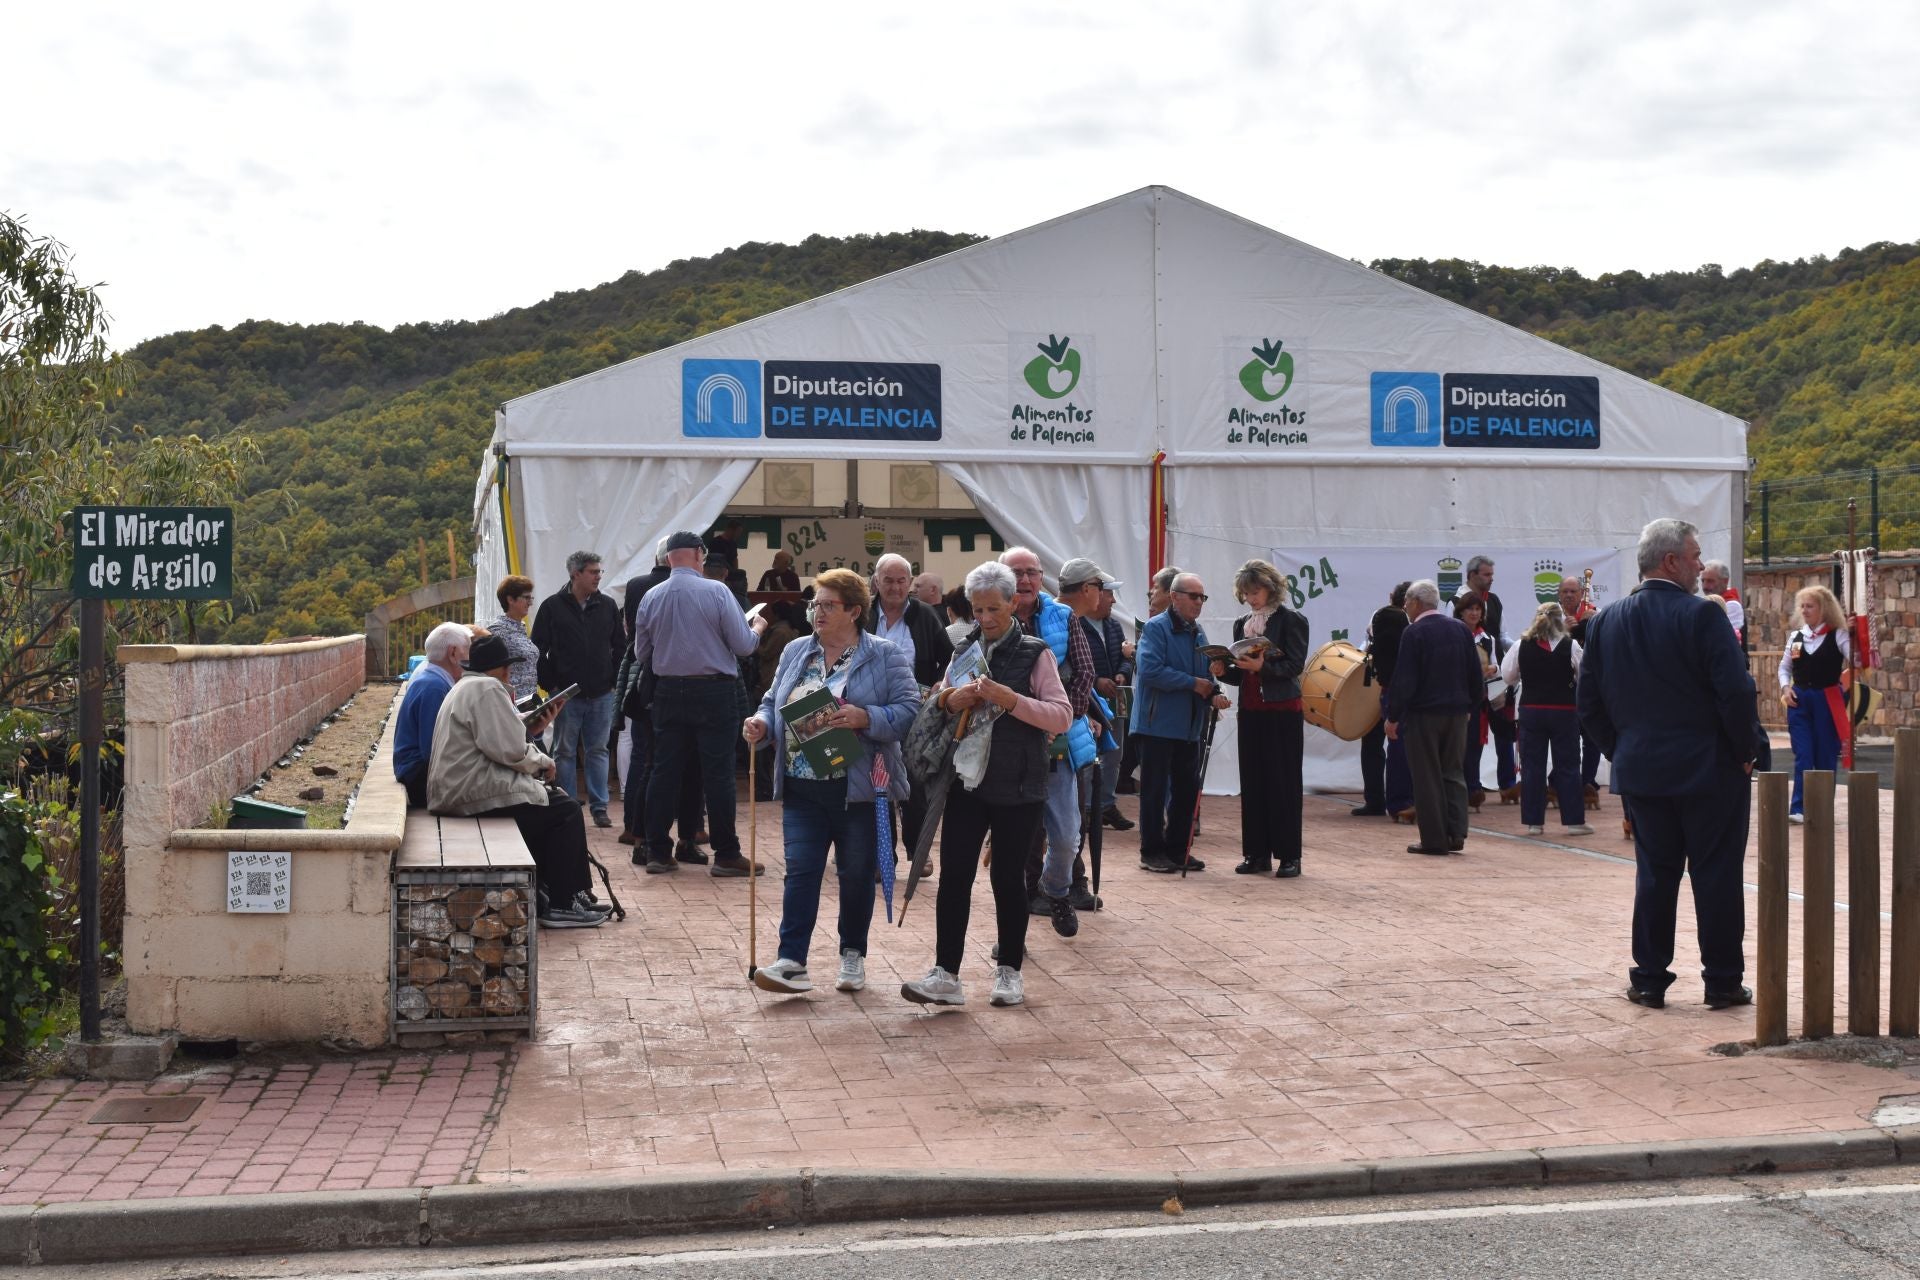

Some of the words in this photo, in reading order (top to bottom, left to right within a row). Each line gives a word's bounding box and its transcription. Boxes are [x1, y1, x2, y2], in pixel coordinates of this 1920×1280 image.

[773, 375, 903, 399] Diputación
[1451, 387, 1566, 410] Diputación
[772, 406, 806, 426] DE
[814, 407, 937, 429] PALENCIA
[1011, 402, 1093, 424] Alimentos
[1228, 404, 1306, 425] Alimentos
[1010, 425, 1026, 441] de
[1032, 423, 1095, 445] Palencia
[1227, 427, 1243, 443] de
[1248, 426, 1308, 447] Palencia
[1450, 416, 1480, 435] DE
[1487, 417, 1596, 438] PALENCIA
[81, 511, 106, 547] El
[115, 512, 225, 547] Mirador
[787, 520, 827, 556] 824
[89, 554, 122, 589] de
[132, 553, 217, 591] Argilo
[1286, 556, 1338, 609] 824
